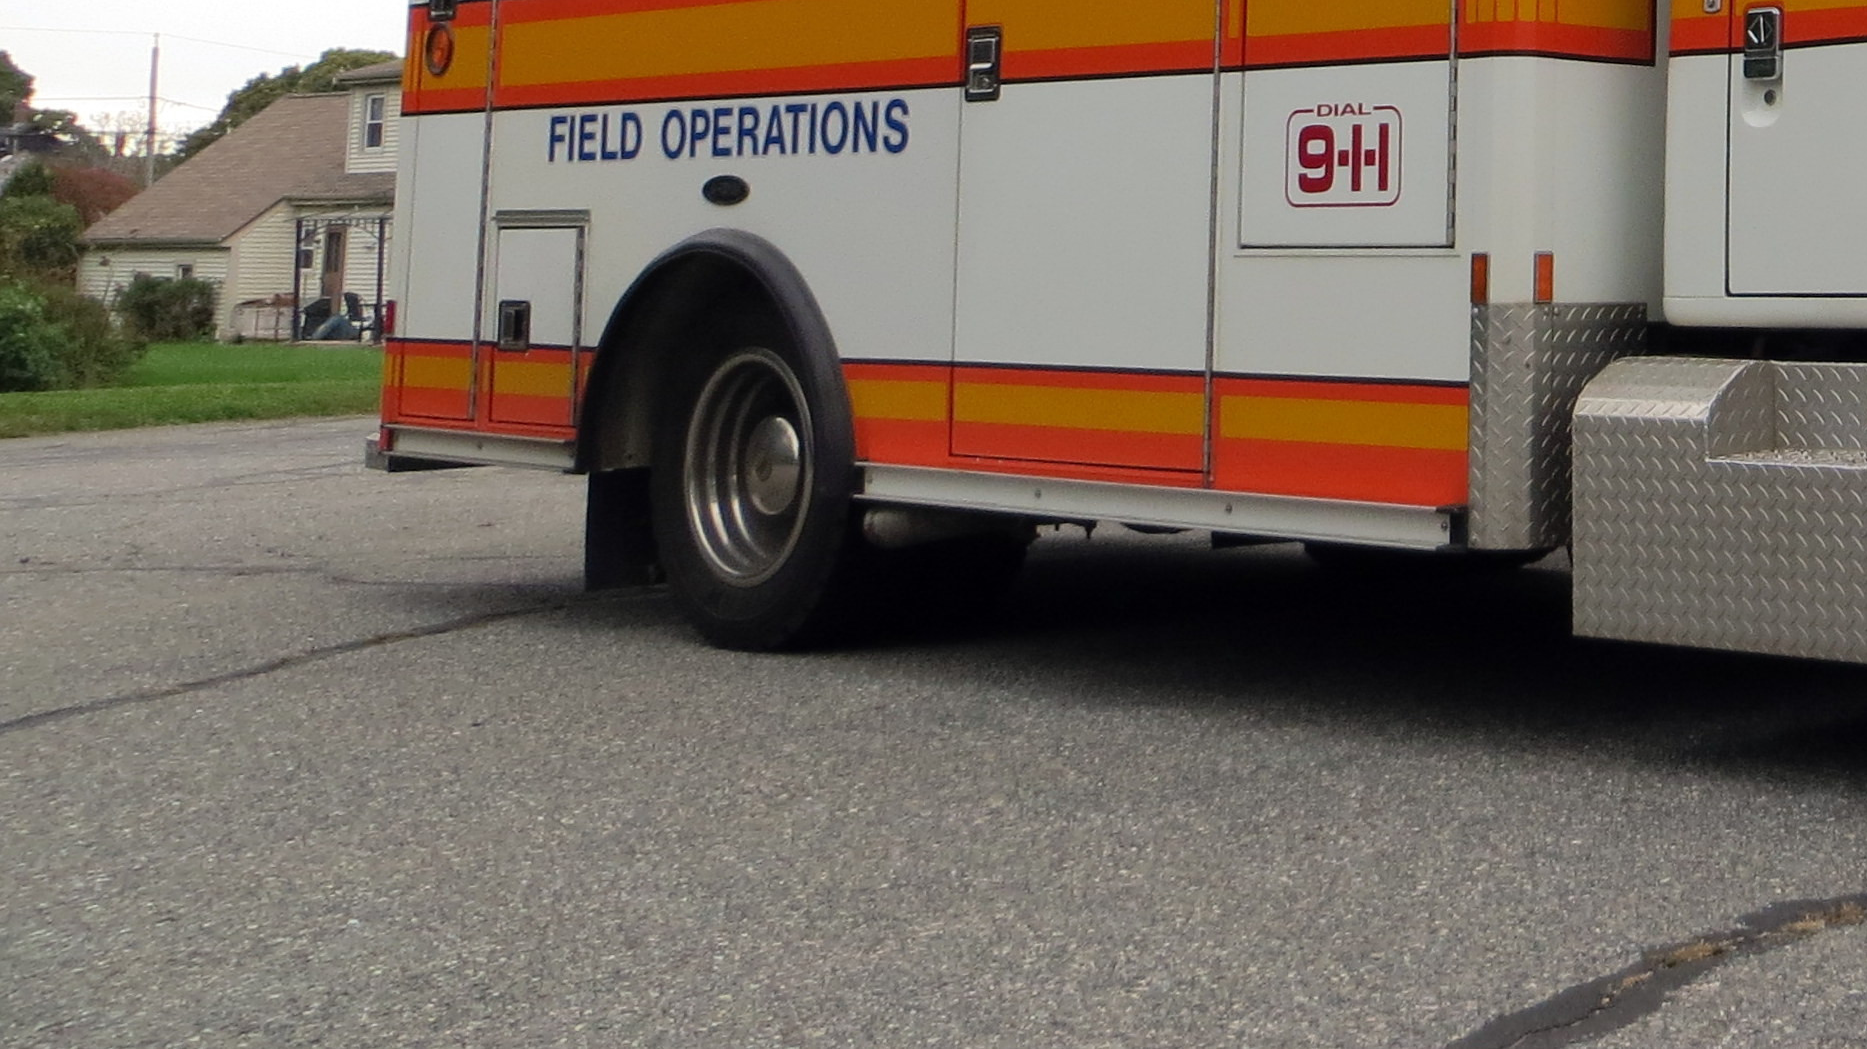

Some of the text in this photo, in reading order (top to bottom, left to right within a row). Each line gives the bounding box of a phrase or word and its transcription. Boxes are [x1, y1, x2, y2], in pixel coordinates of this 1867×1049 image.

[1316, 103, 1372, 118] DIAL
[548, 99, 910, 162] FIELD OPERATIONS
